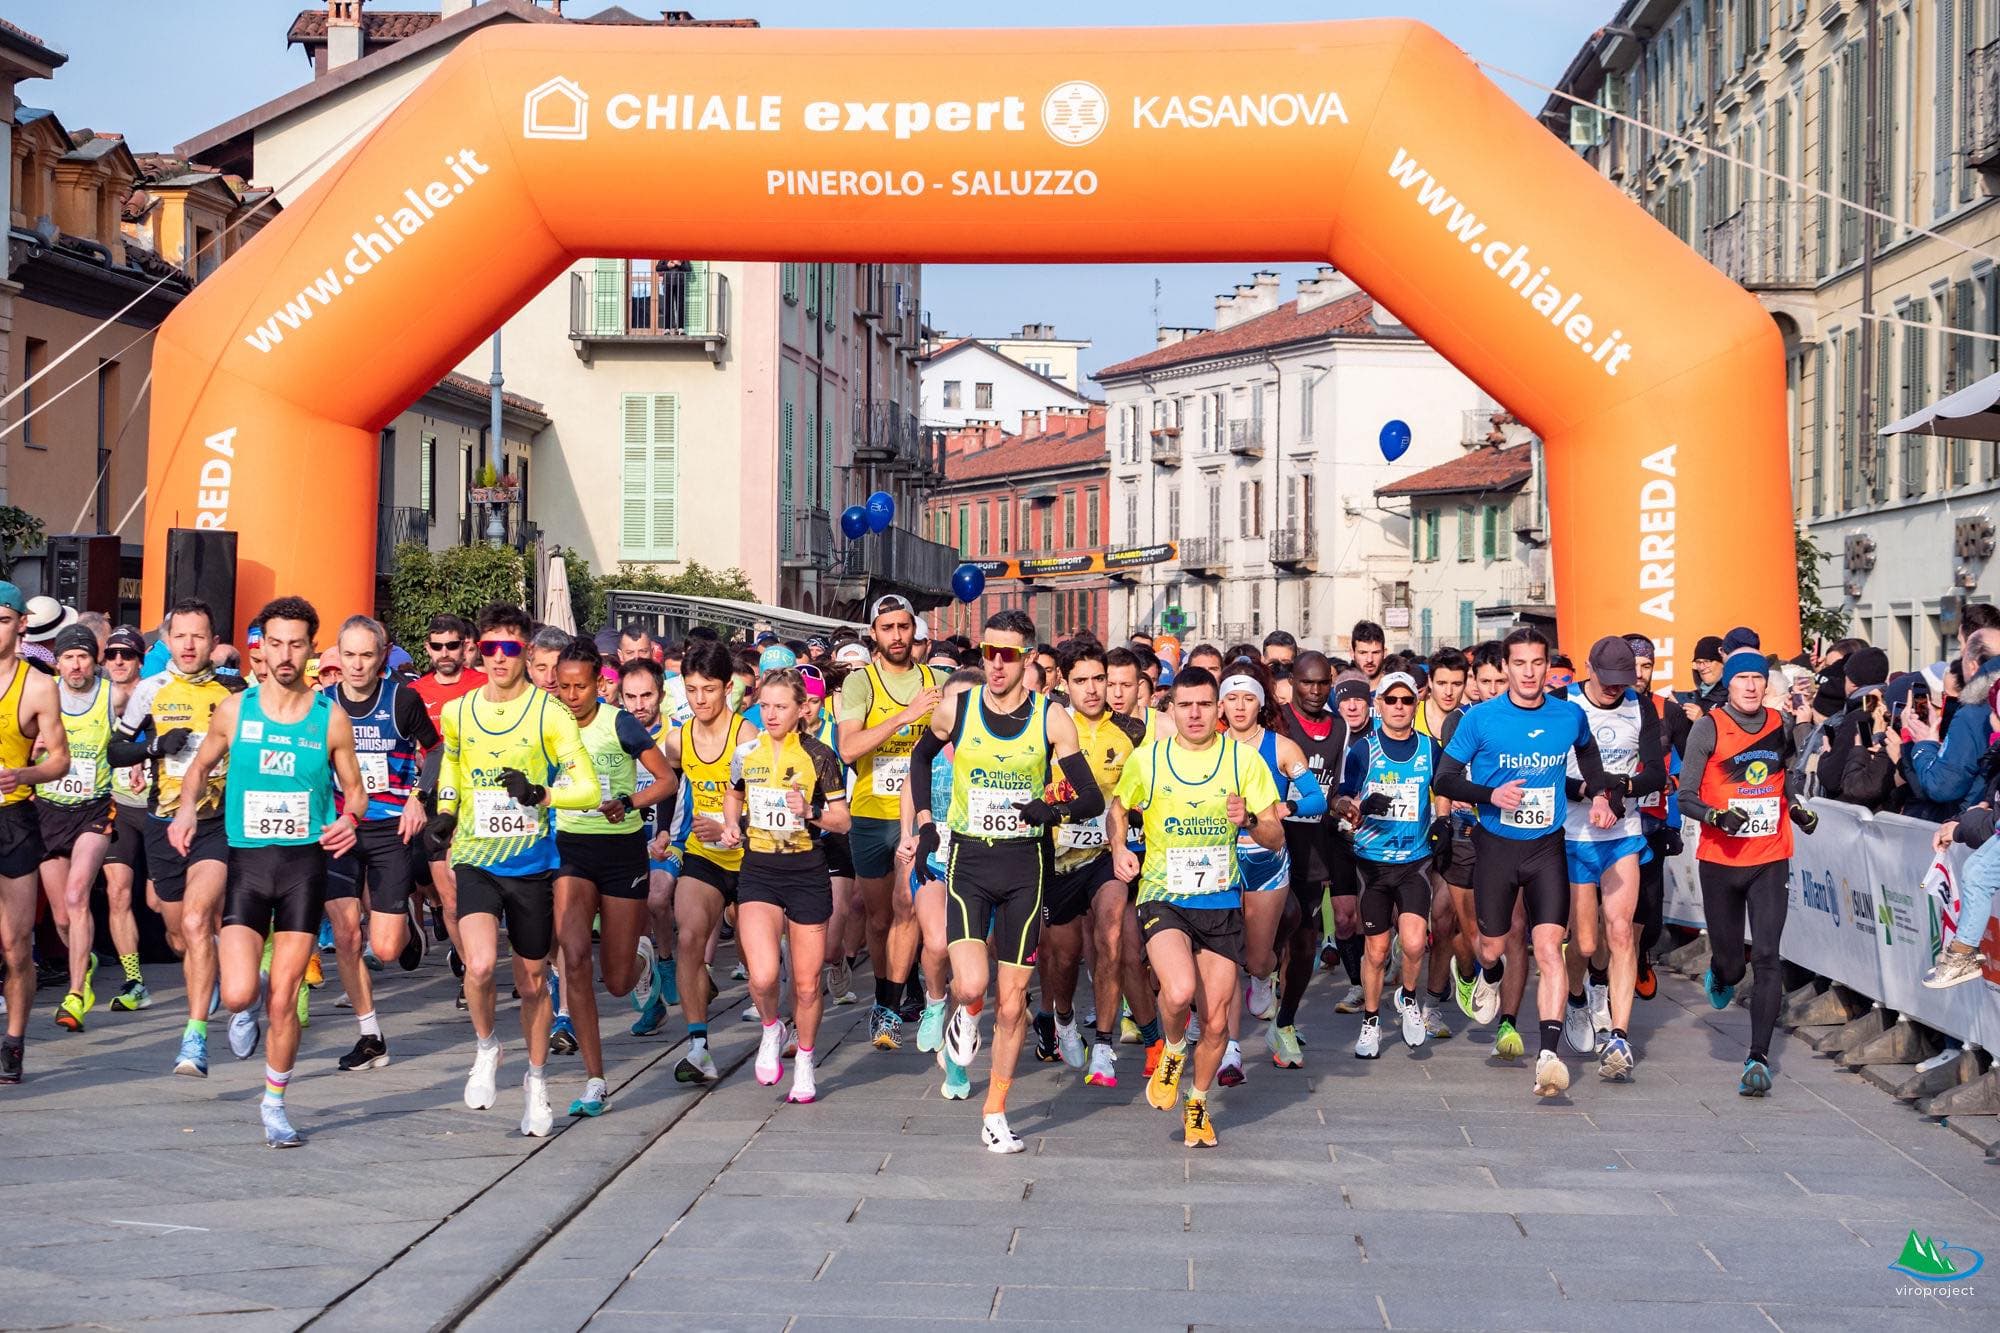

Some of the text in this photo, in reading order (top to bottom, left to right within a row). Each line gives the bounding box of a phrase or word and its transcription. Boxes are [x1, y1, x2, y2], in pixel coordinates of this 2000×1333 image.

[606, 91, 1349, 138] CHIALE expert KASANOVA
[767, 170, 925, 196] PINEROLO
[952, 169, 1098, 196] SALUZZO
[244, 147, 490, 354] www.chiale.it
[1388, 147, 1632, 376] www.chiale.it
[195, 427, 237, 530] REDA
[1640, 444, 1677, 622] ARREDA
[352, 726, 380, 739] ETICA
[1499, 752, 1566, 769] FisioSport
[988, 771, 1032, 781] atletica
[56, 780, 82, 794] 760
[692, 781, 727, 792] SCOTT
[886, 778, 905, 792] 92
[983, 779, 1032, 790] SALUZZO
[1381, 804, 1407, 817] 17
[1514, 810, 1545, 825] 636
[260, 818, 296, 835] 878
[489, 816, 525, 833] 864
[766, 812, 786, 827] 10
[983, 815, 1018, 831] 863
[1182, 816, 1228, 826] atletica
[1177, 825, 1227, 836] SALUZZO
[1072, 831, 1102, 846] 723
[1194, 871, 1206, 888] 7
